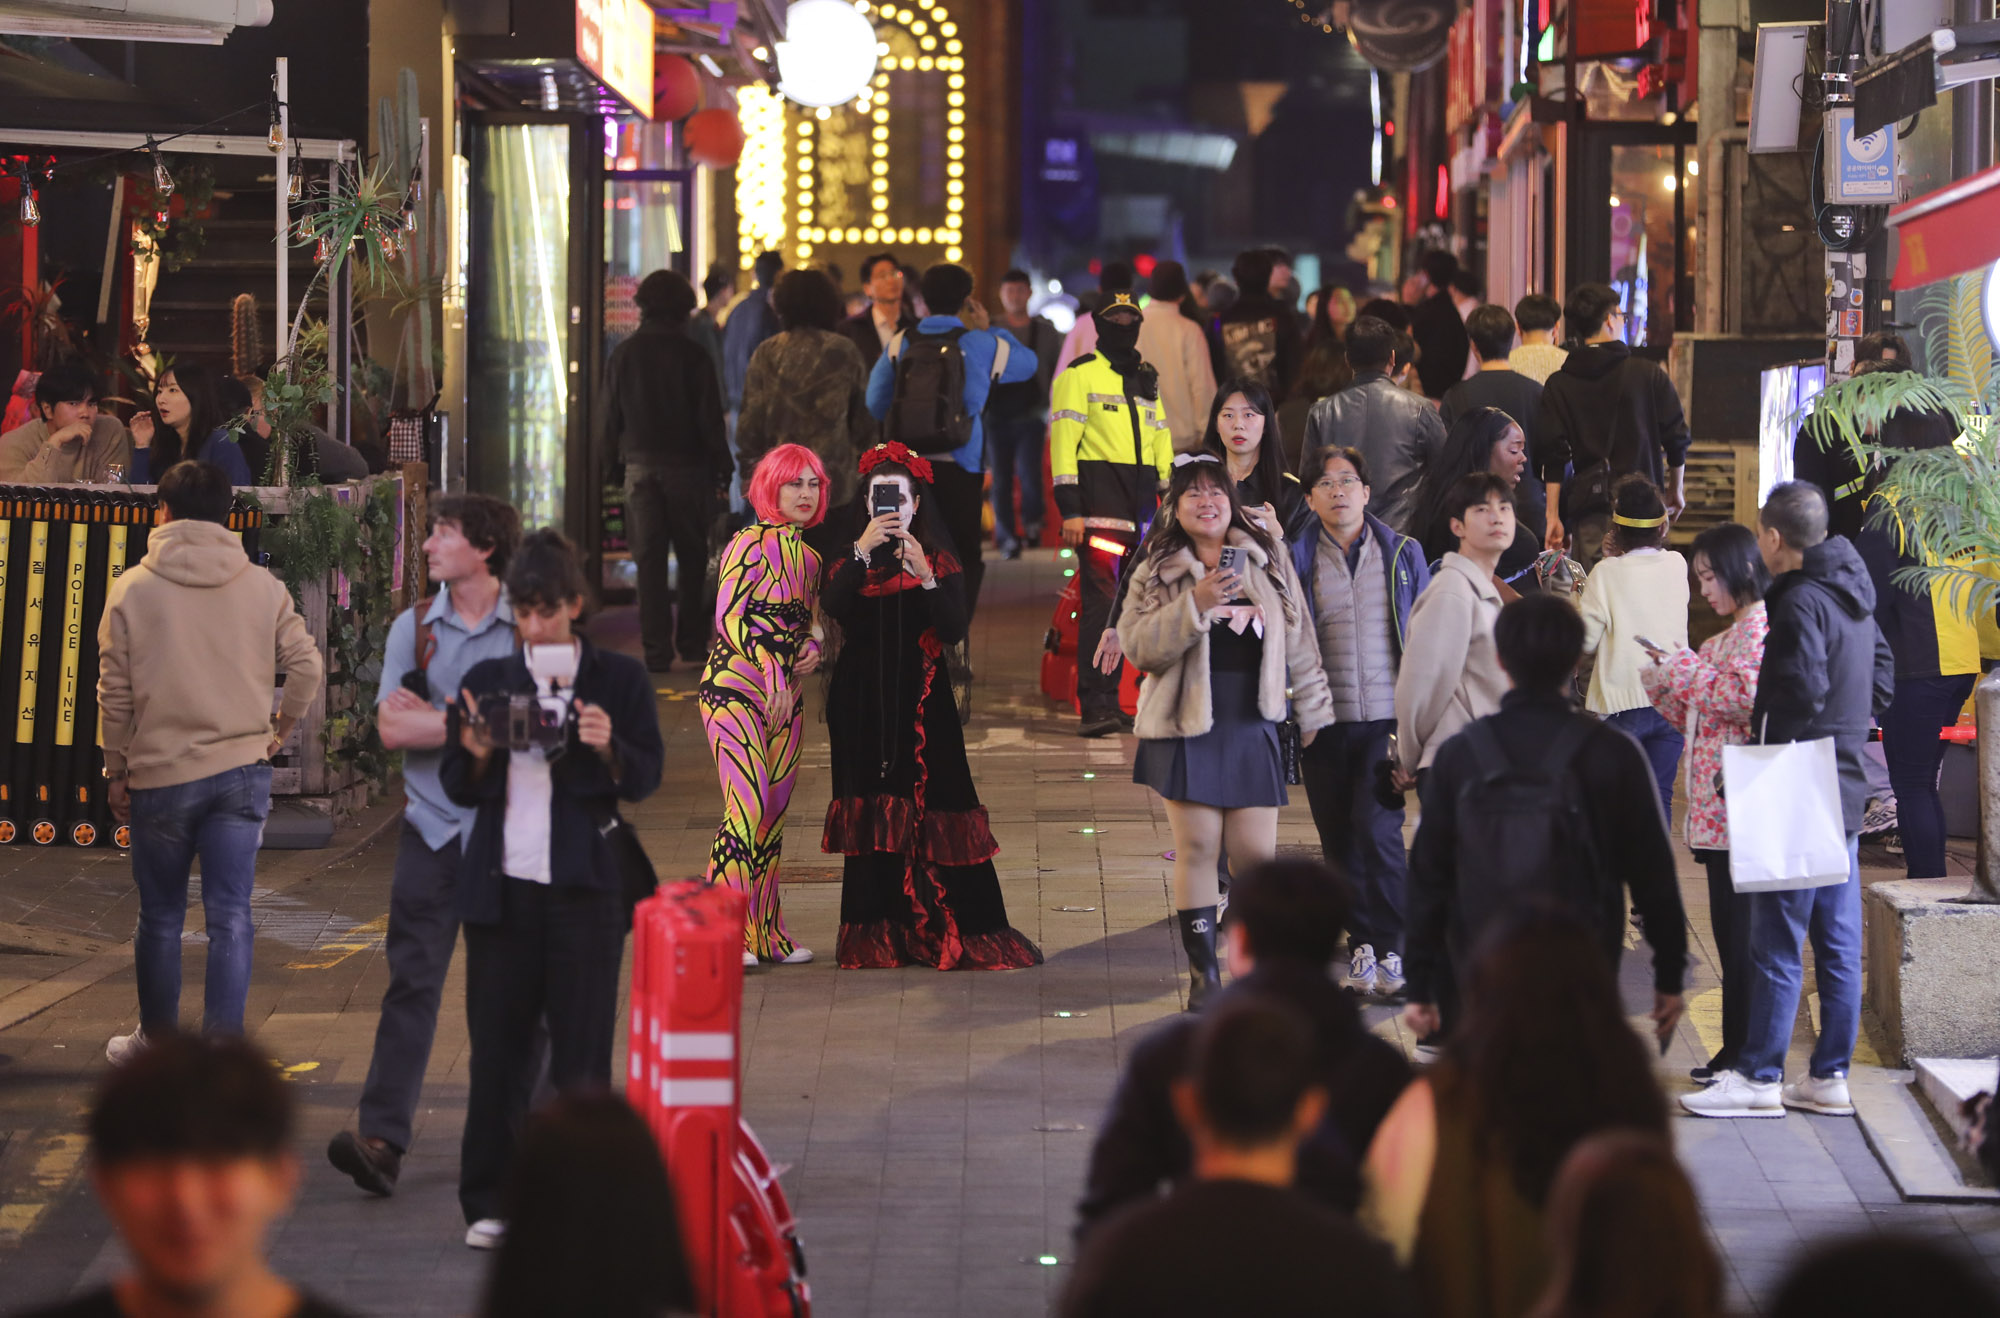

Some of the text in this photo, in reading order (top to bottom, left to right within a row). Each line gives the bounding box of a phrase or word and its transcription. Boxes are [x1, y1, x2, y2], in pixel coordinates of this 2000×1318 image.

[22, 561, 45, 720] 질서유지선
[63, 564, 82, 722] POLICE LINE
